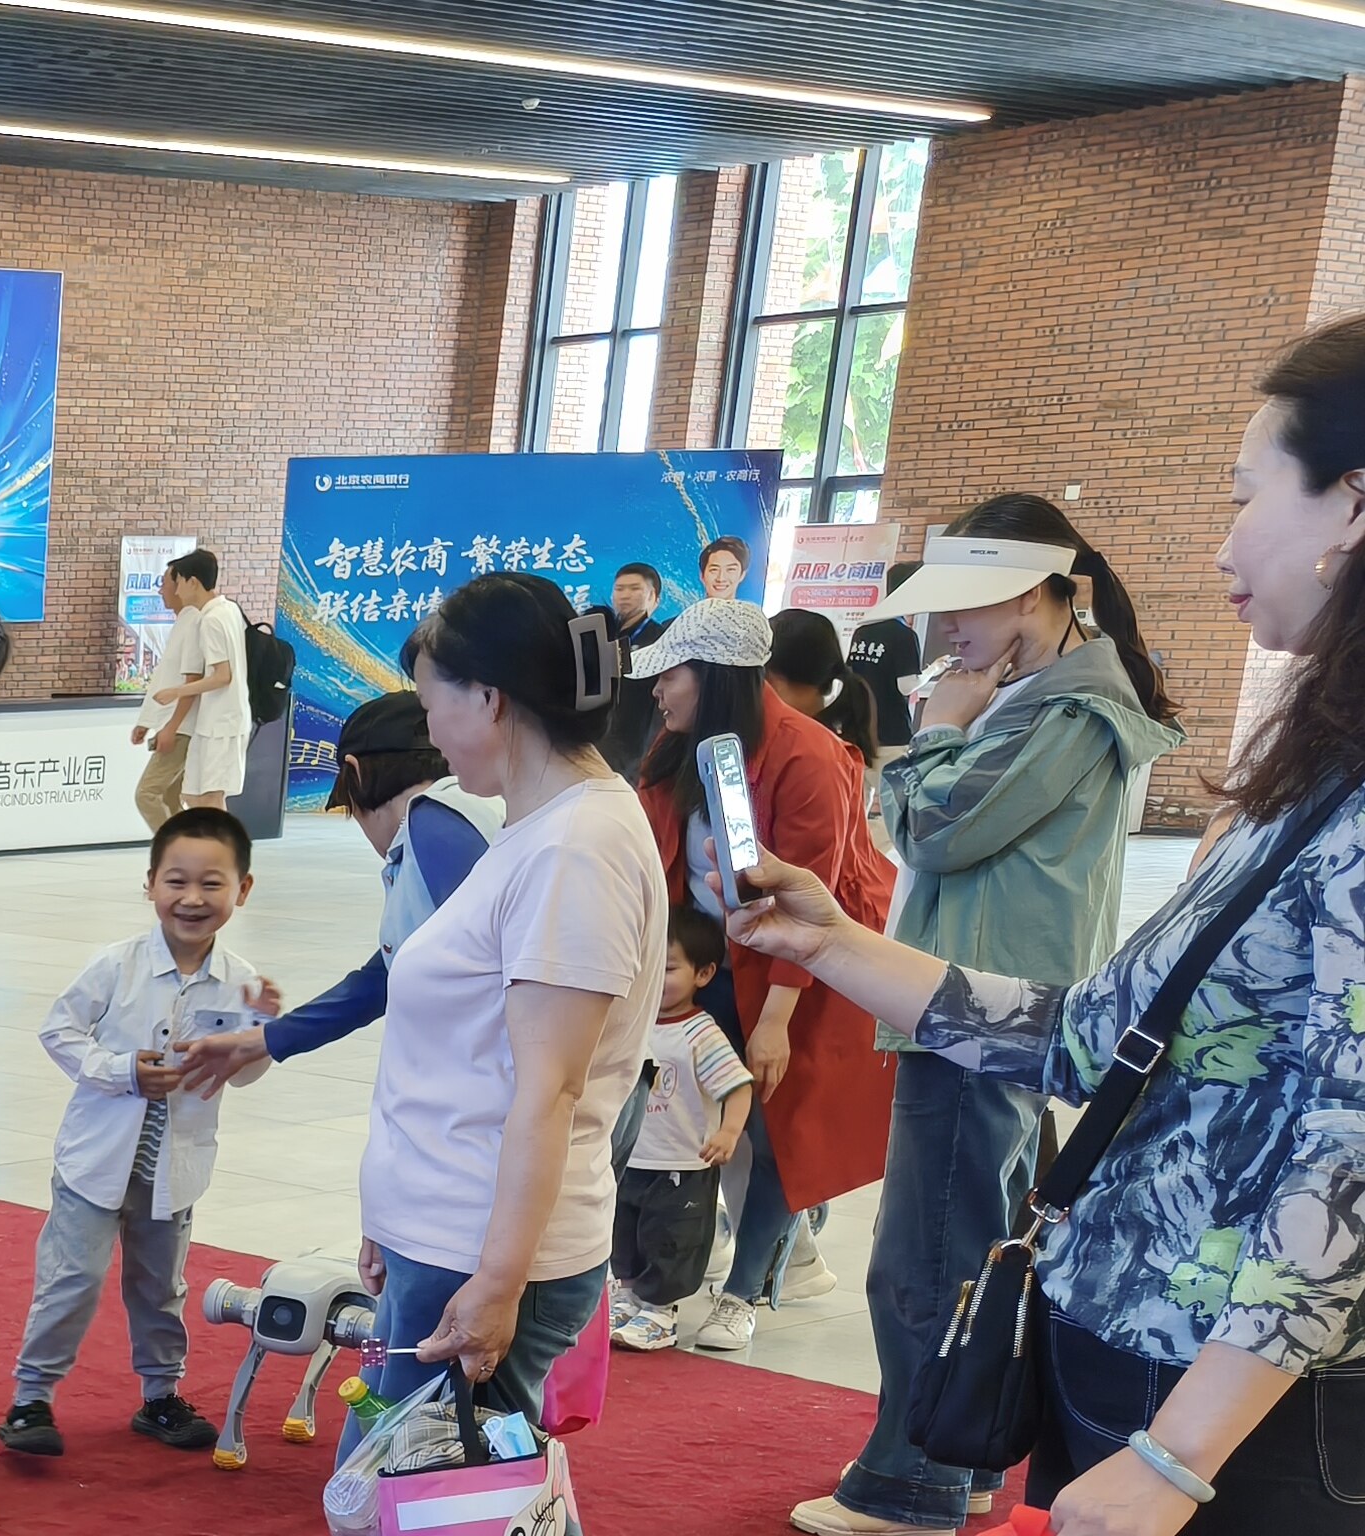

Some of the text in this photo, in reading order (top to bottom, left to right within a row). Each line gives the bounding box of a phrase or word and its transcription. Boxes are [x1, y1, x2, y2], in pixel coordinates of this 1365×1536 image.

[335, 474, 409, 485] 北京农商银行
[314, 533, 595, 580] 智慧农商 繁荣生态
